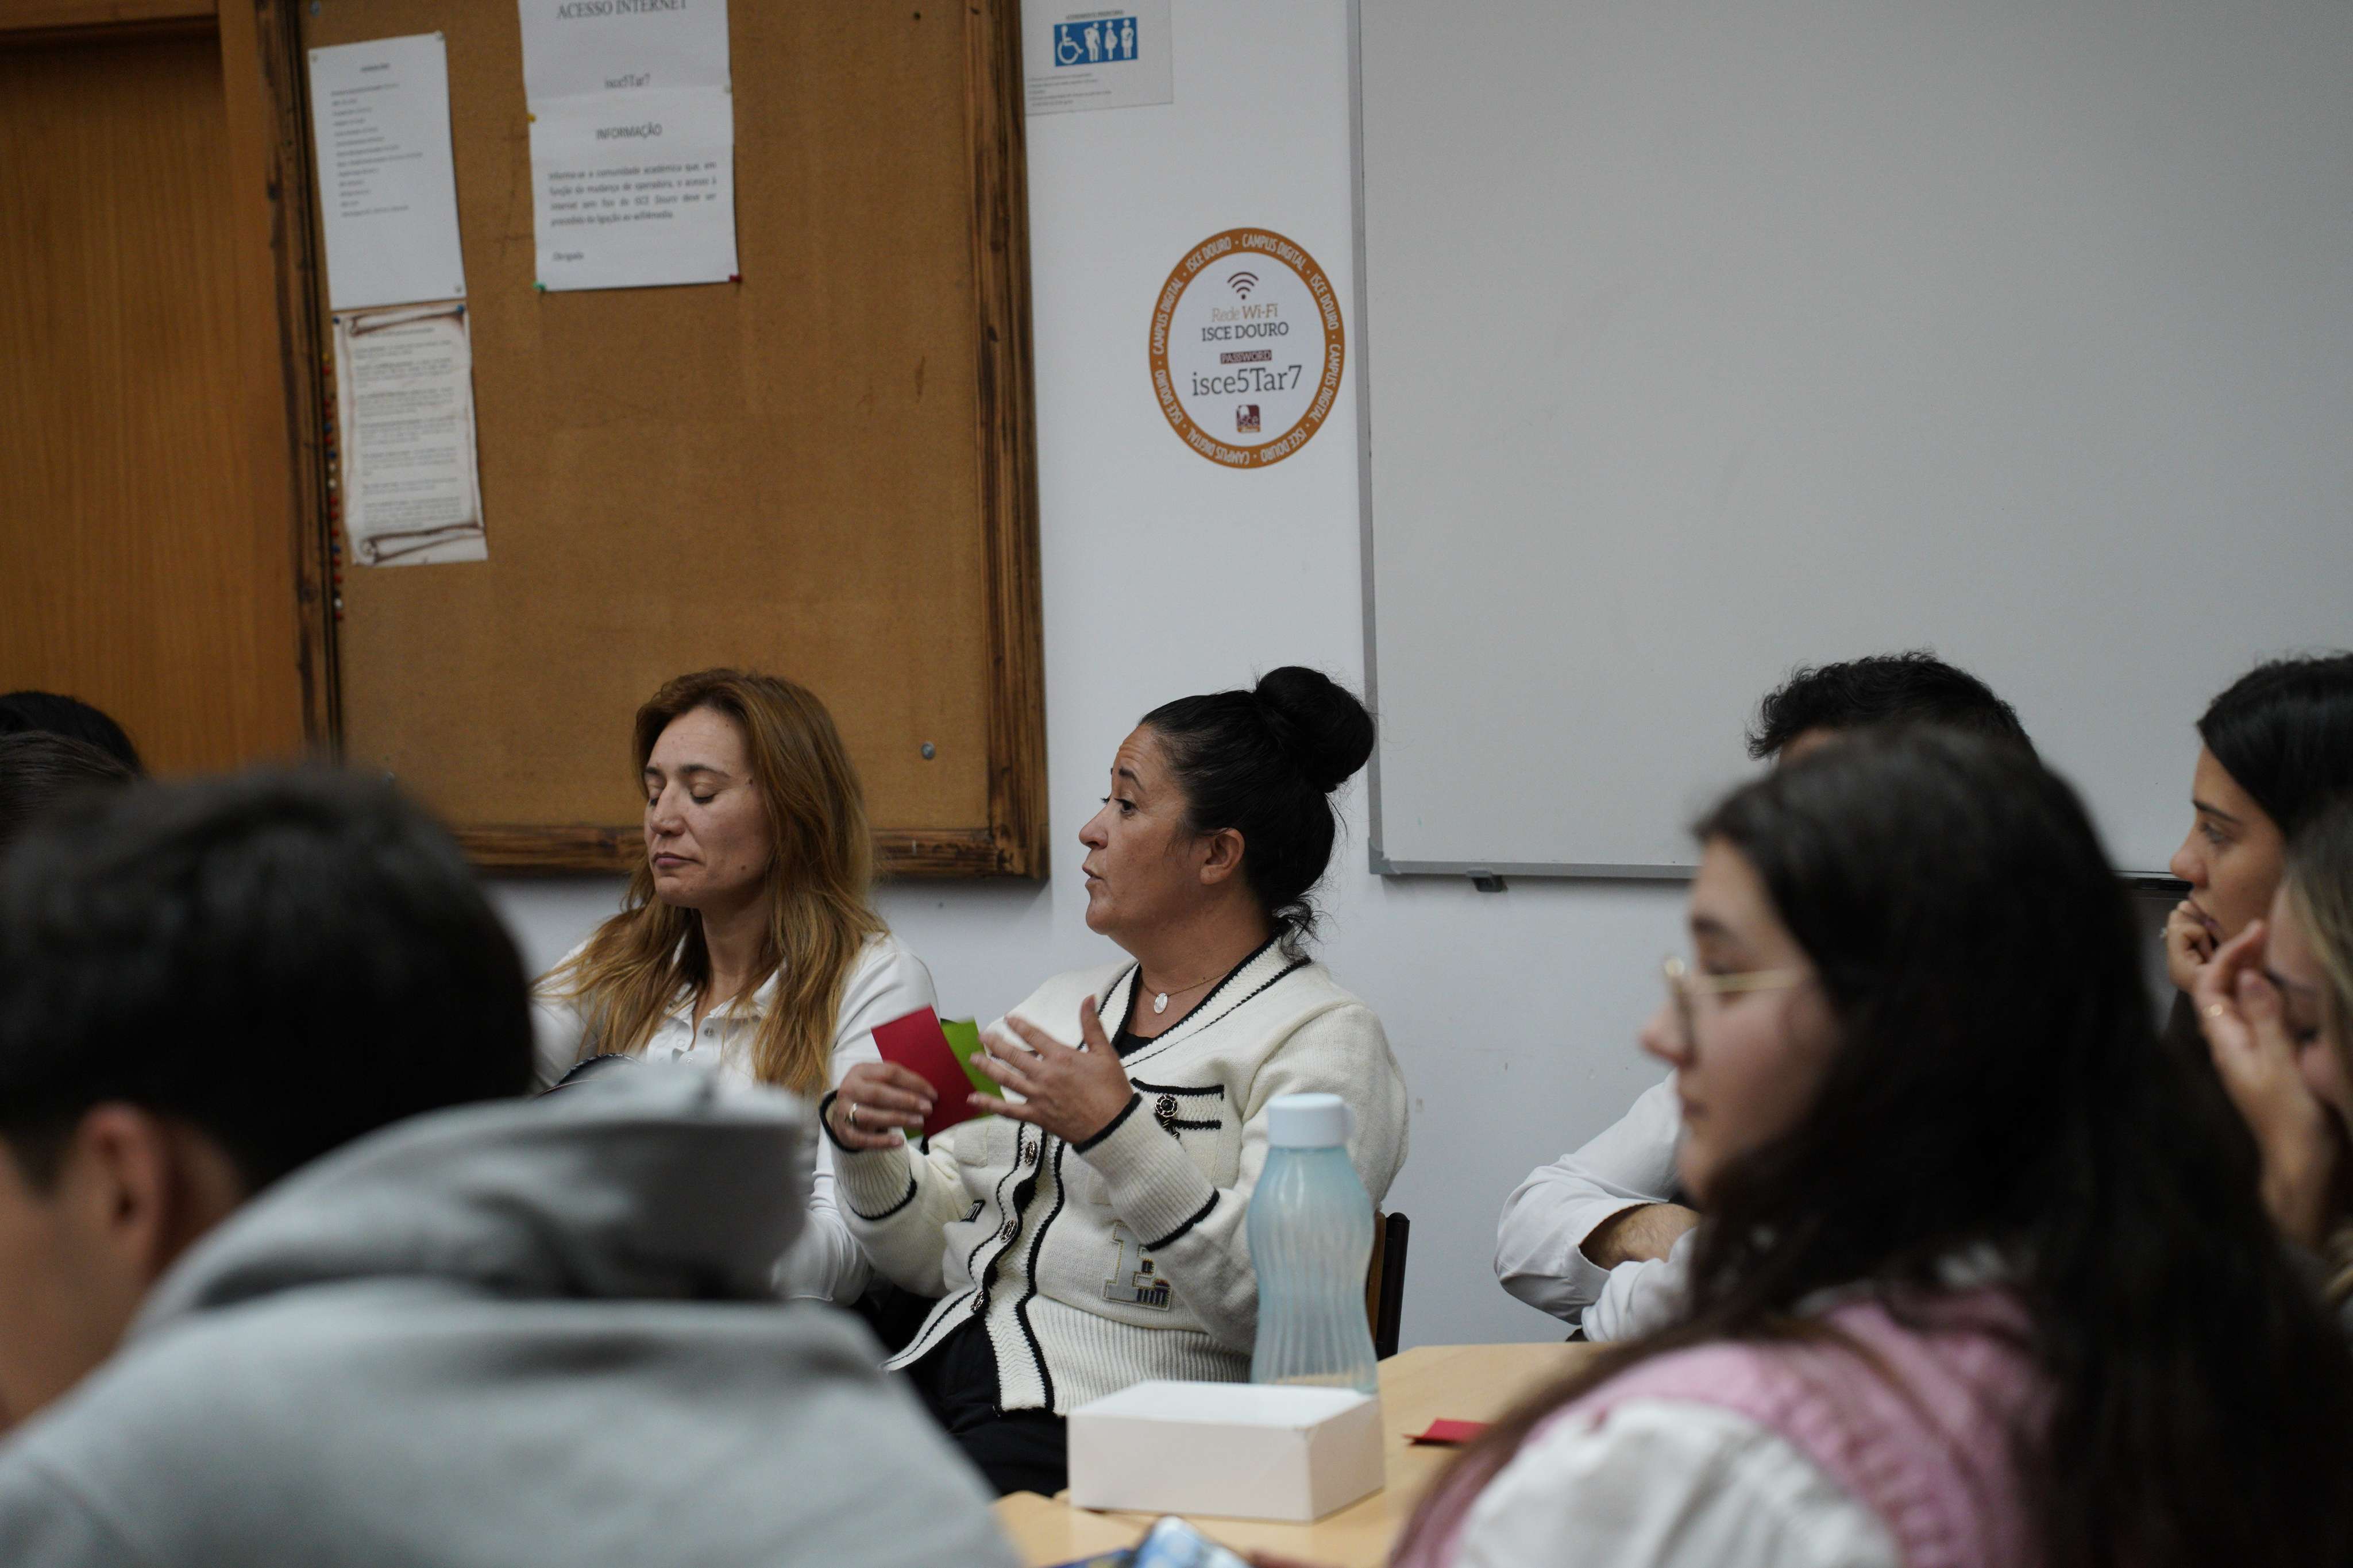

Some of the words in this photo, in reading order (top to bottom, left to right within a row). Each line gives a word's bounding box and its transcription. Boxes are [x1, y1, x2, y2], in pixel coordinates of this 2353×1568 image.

[557, 1, 613, 19] ACESSO
[596, 122, 663, 140] INFORMAÇÃO
[1186, 251, 1205, 273] ISCE
[1202, 236, 1232, 259] DOURO
[1241, 233, 1278, 253] CAMPUS
[1277, 242, 1307, 271] DIGITAL
[1160, 278, 1185, 313] DIGITAL
[1310, 272, 1327, 296] ISCE
[1320, 293, 1339, 331] DOURO
[1212, 306, 1240, 322] Rede
[1241, 303, 1278, 319] Wi-Fi
[1152, 312, 1169, 355] CAMPUS
[1202, 326, 1232, 342] ISCE
[1235, 322, 1289, 339] DOURO
[1221, 350, 1271, 364] PASSWORD
[1325, 343, 1342, 388] CAMPUS
[1192, 364, 1303, 396] isce5Tar7
[1309, 387, 1333, 422] DIGITAL
[1214, 446, 1250, 465] CAMPUS
